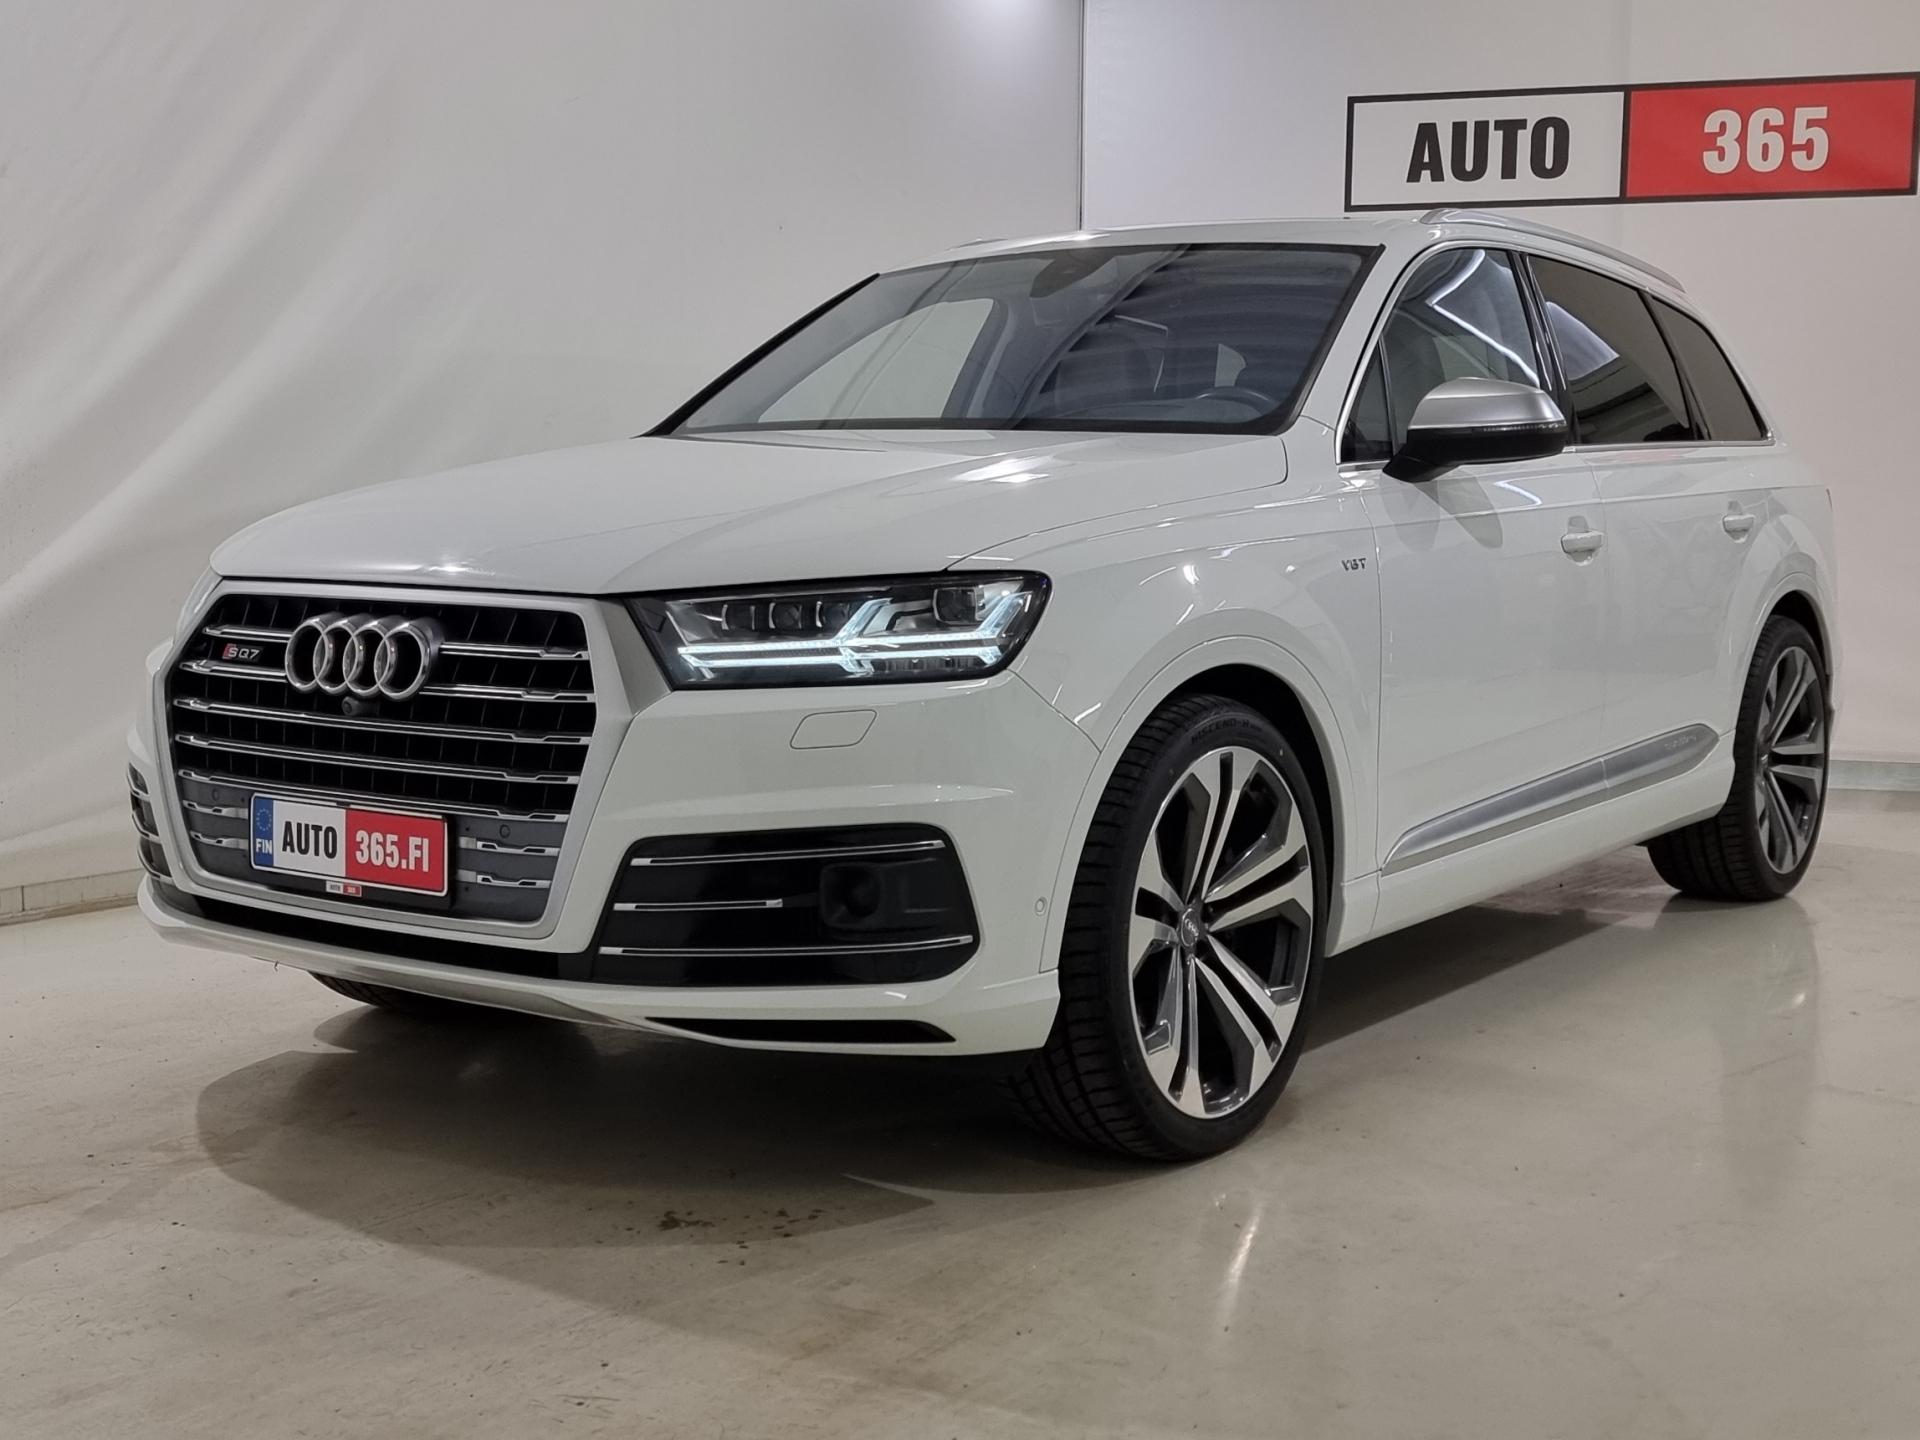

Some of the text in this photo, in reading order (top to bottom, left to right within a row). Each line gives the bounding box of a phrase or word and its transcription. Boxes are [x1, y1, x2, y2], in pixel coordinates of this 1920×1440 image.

[1406, 106, 1829, 183] AUTO 365
[225, 646, 260, 660] SQ7
[255, 838, 273, 855] FIN
[282, 820, 430, 873] AUTO 365.FI
